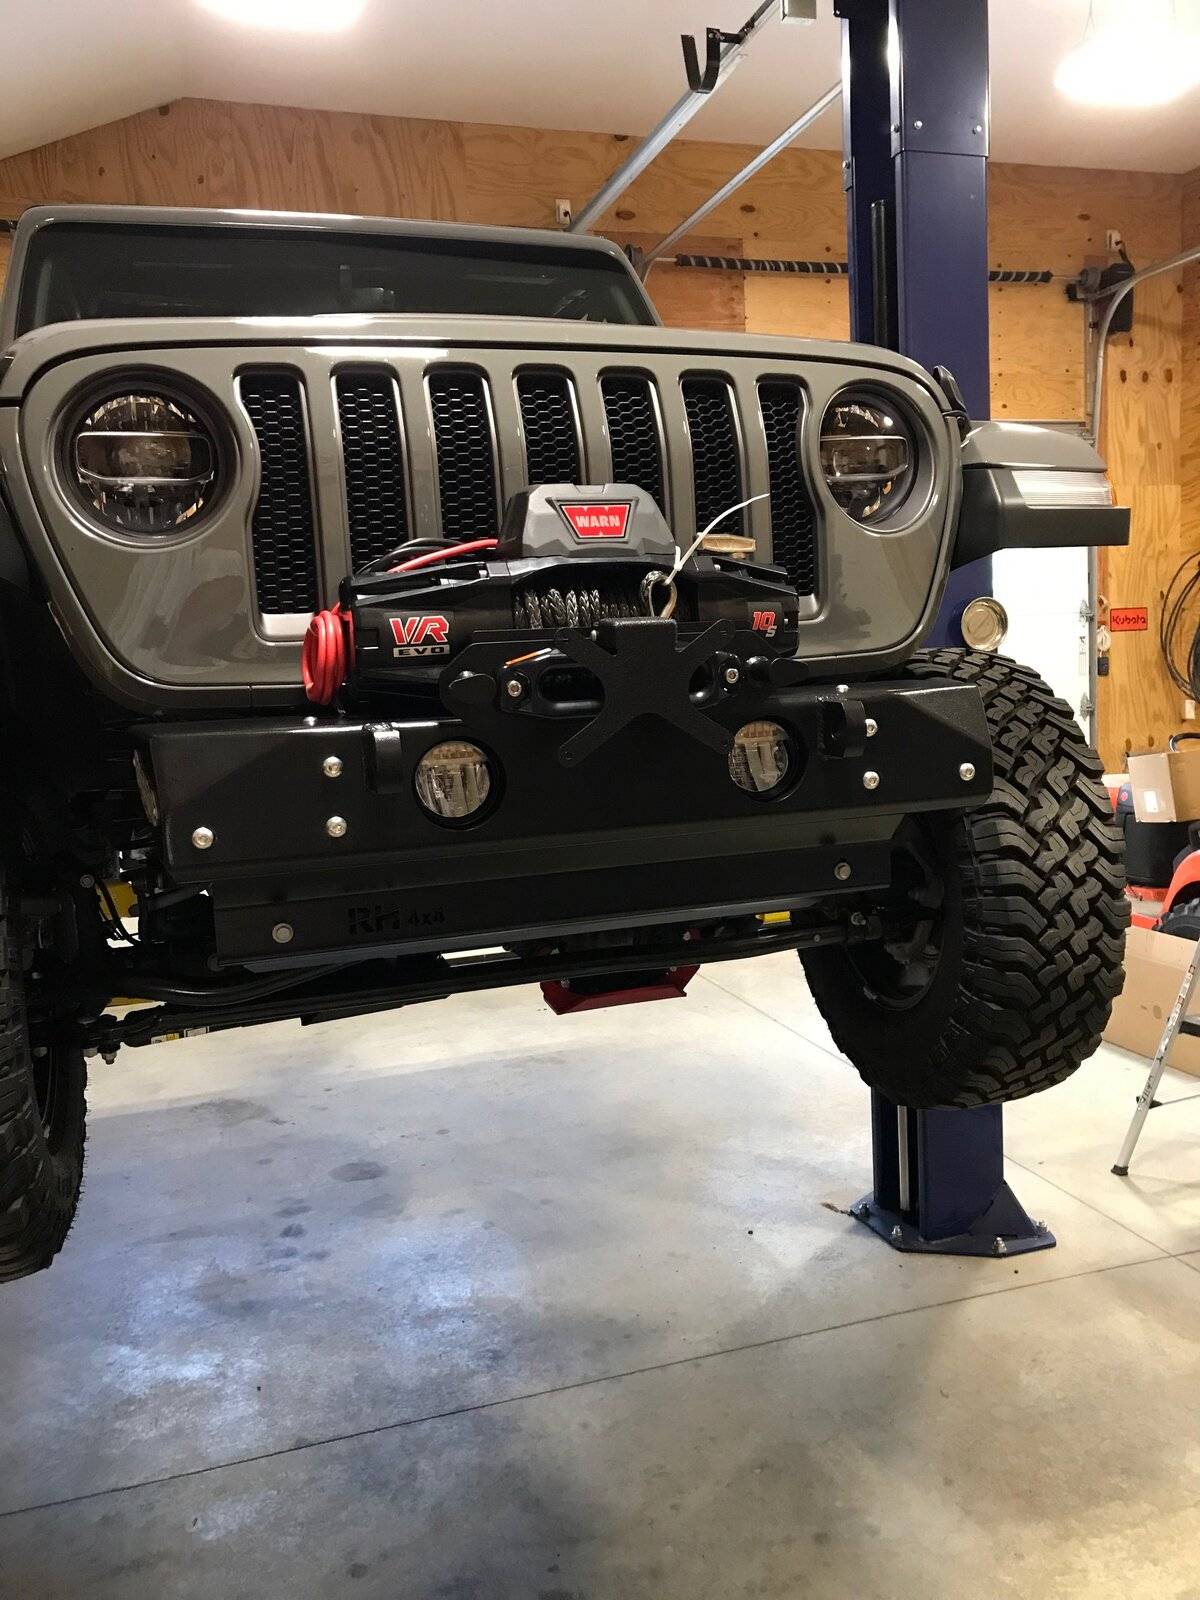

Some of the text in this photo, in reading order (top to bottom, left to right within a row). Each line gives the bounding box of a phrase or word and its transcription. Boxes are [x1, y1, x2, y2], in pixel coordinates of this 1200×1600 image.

[575, 515, 620, 528] WARN
[1112, 615, 1146, 625] Kubota
[389, 615, 450, 645] VR
[397, 646, 445, 656] EVO
